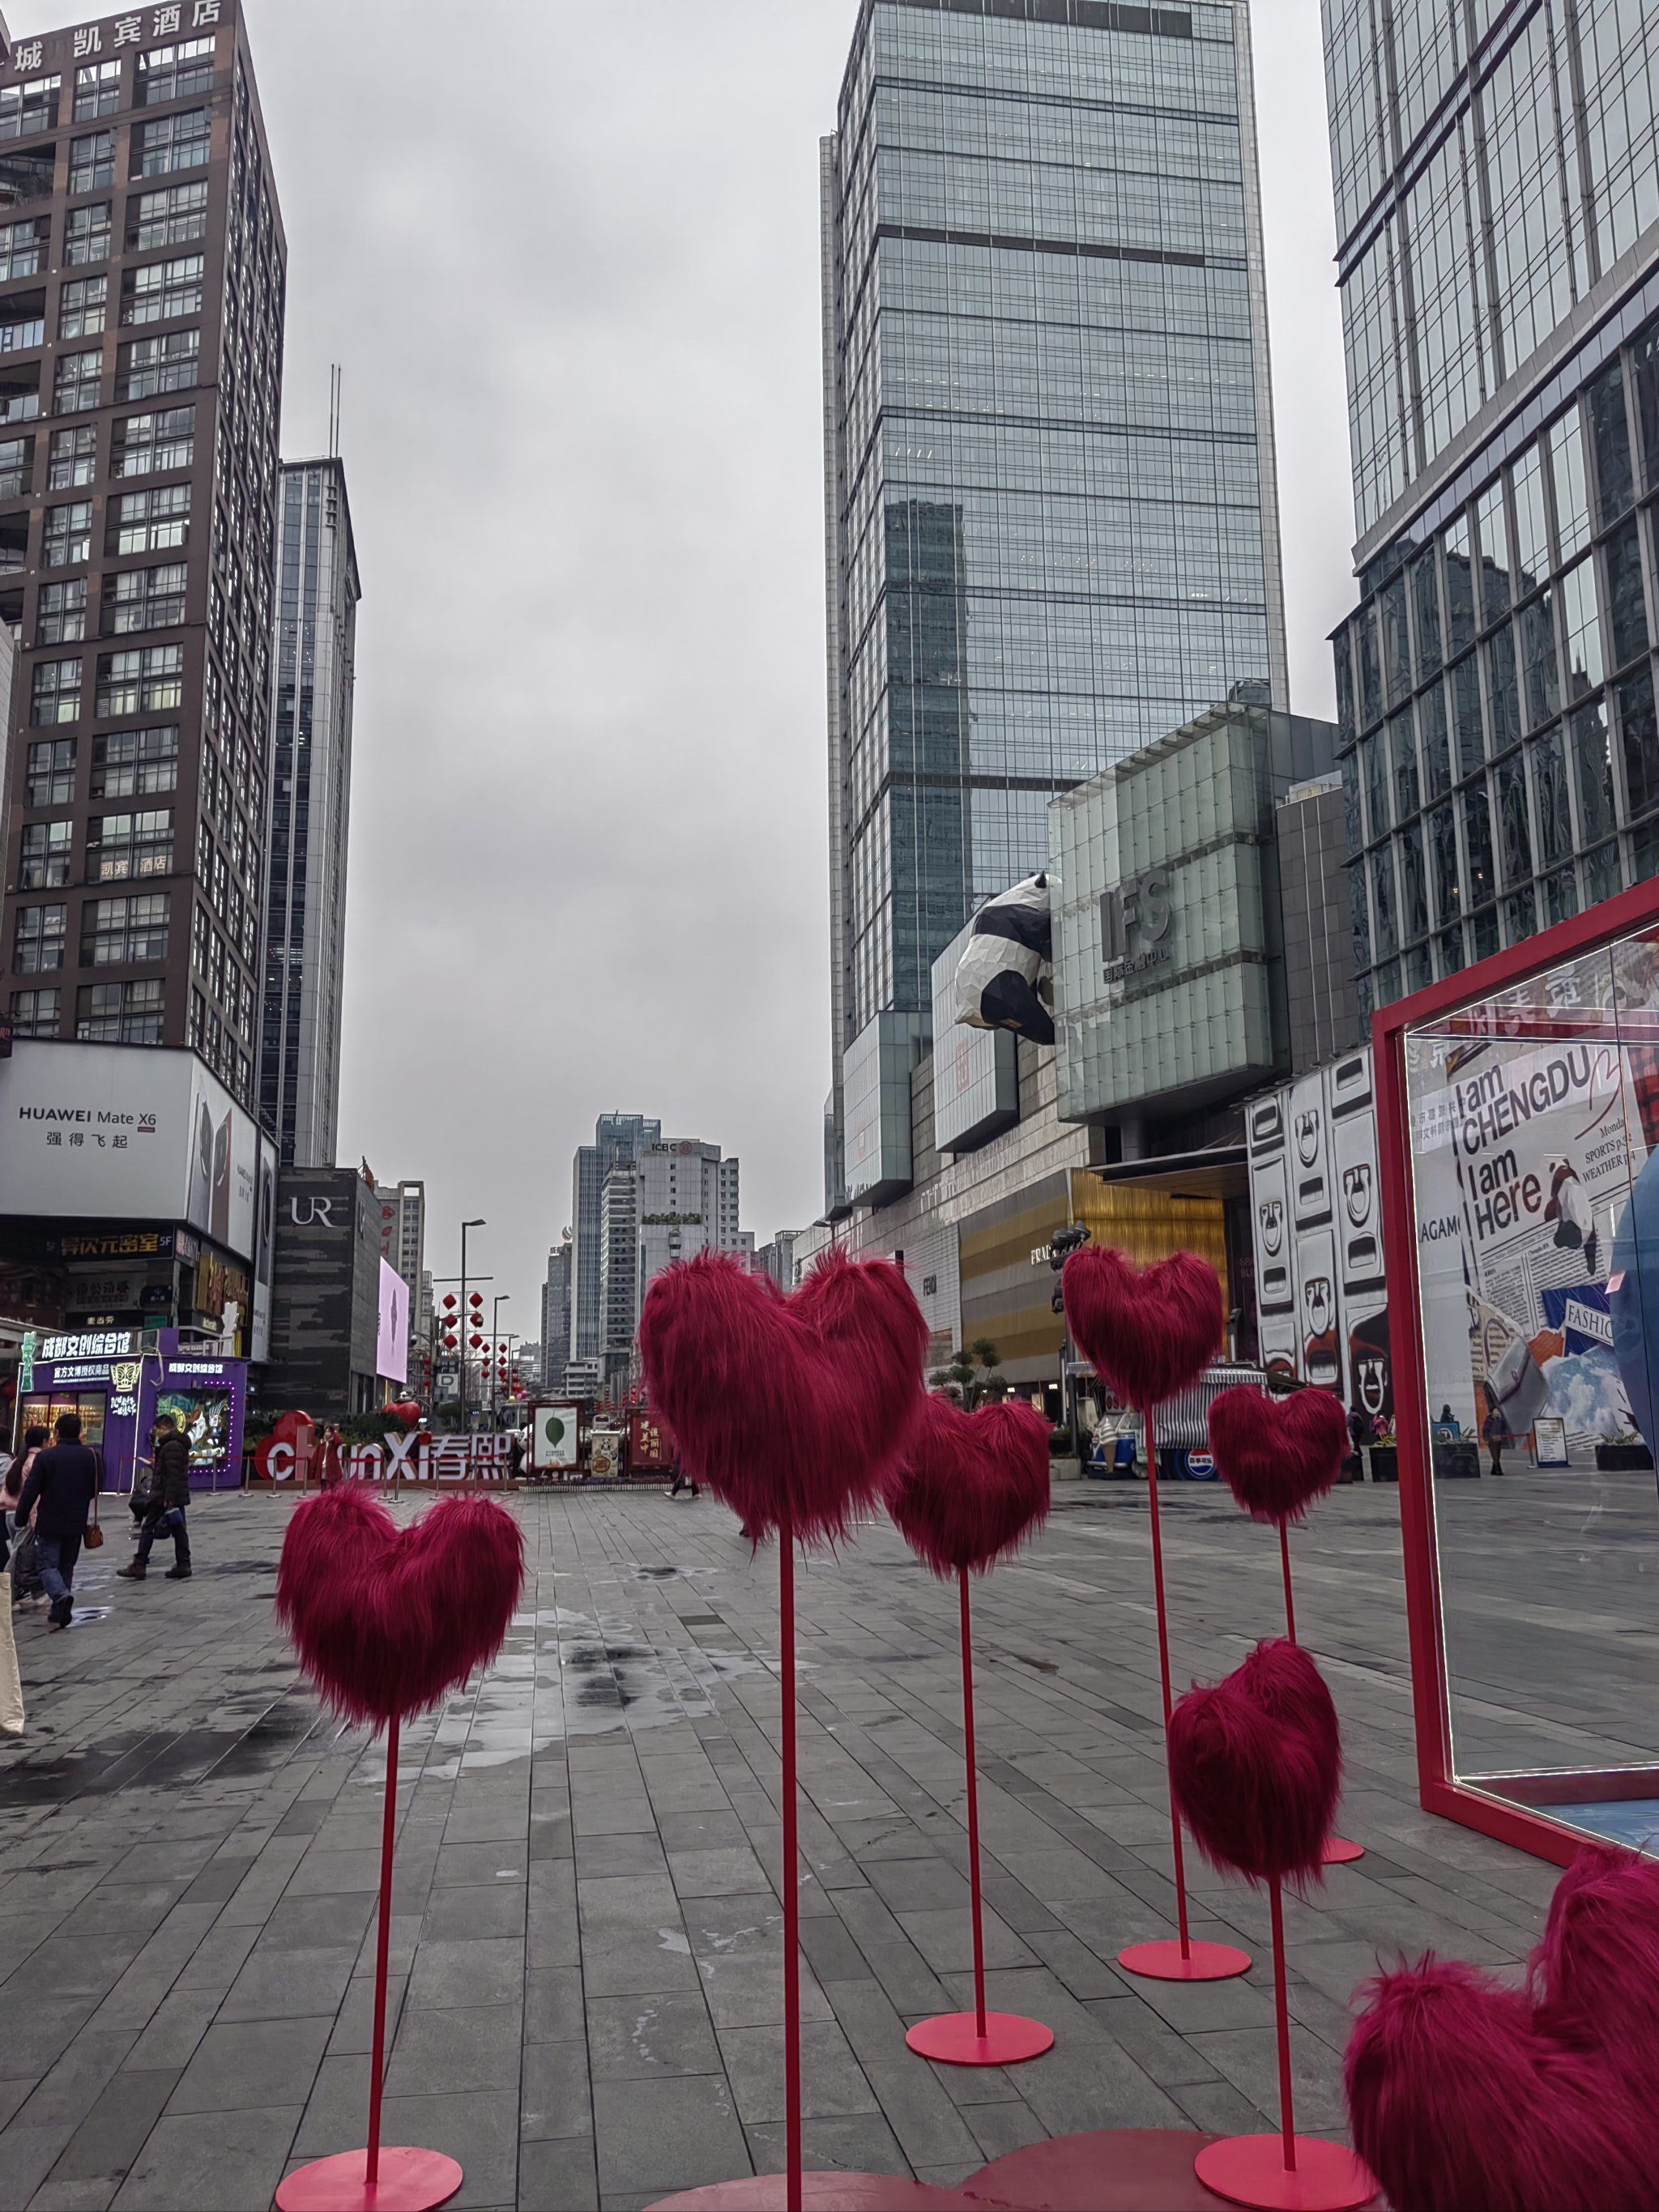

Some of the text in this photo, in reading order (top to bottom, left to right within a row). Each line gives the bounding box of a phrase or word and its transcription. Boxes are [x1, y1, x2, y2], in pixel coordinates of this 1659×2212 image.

[1099, 868, 1171, 962] IFS
[1103, 947, 1171, 985] 国际金融中心
[1462, 1045, 1591, 1156] CHENGDU
[1465, 1065, 1504, 1113] am
[19, 1106, 156, 1126] HUAWEI Mate X6
[46, 1132, 128, 1149] 强得飞起
[1599, 1119, 1626, 1139] Monda
[651, 1143, 677, 1152] ICBC
[1584, 1140, 1615, 1164] SPORTS
[1468, 1149, 1519, 1201] I am
[1582, 1154, 1623, 1183] WEATHER
[289, 1196, 338, 1228] UR
[1473, 1174, 1542, 1241] Here
[61, 1233, 160, 1256] 异次元密室
[160, 1236, 173, 1247] 5F
[923, 1274, 937, 1297] FENDI
[87, 1315, 115, 1325] 麦当劳
[42, 1332, 131, 1358] 成都文创综合馆
[54, 1363, 110, 1379] 官方文博授权商品
[168, 1362, 224, 1375] 成都文创综合馆
